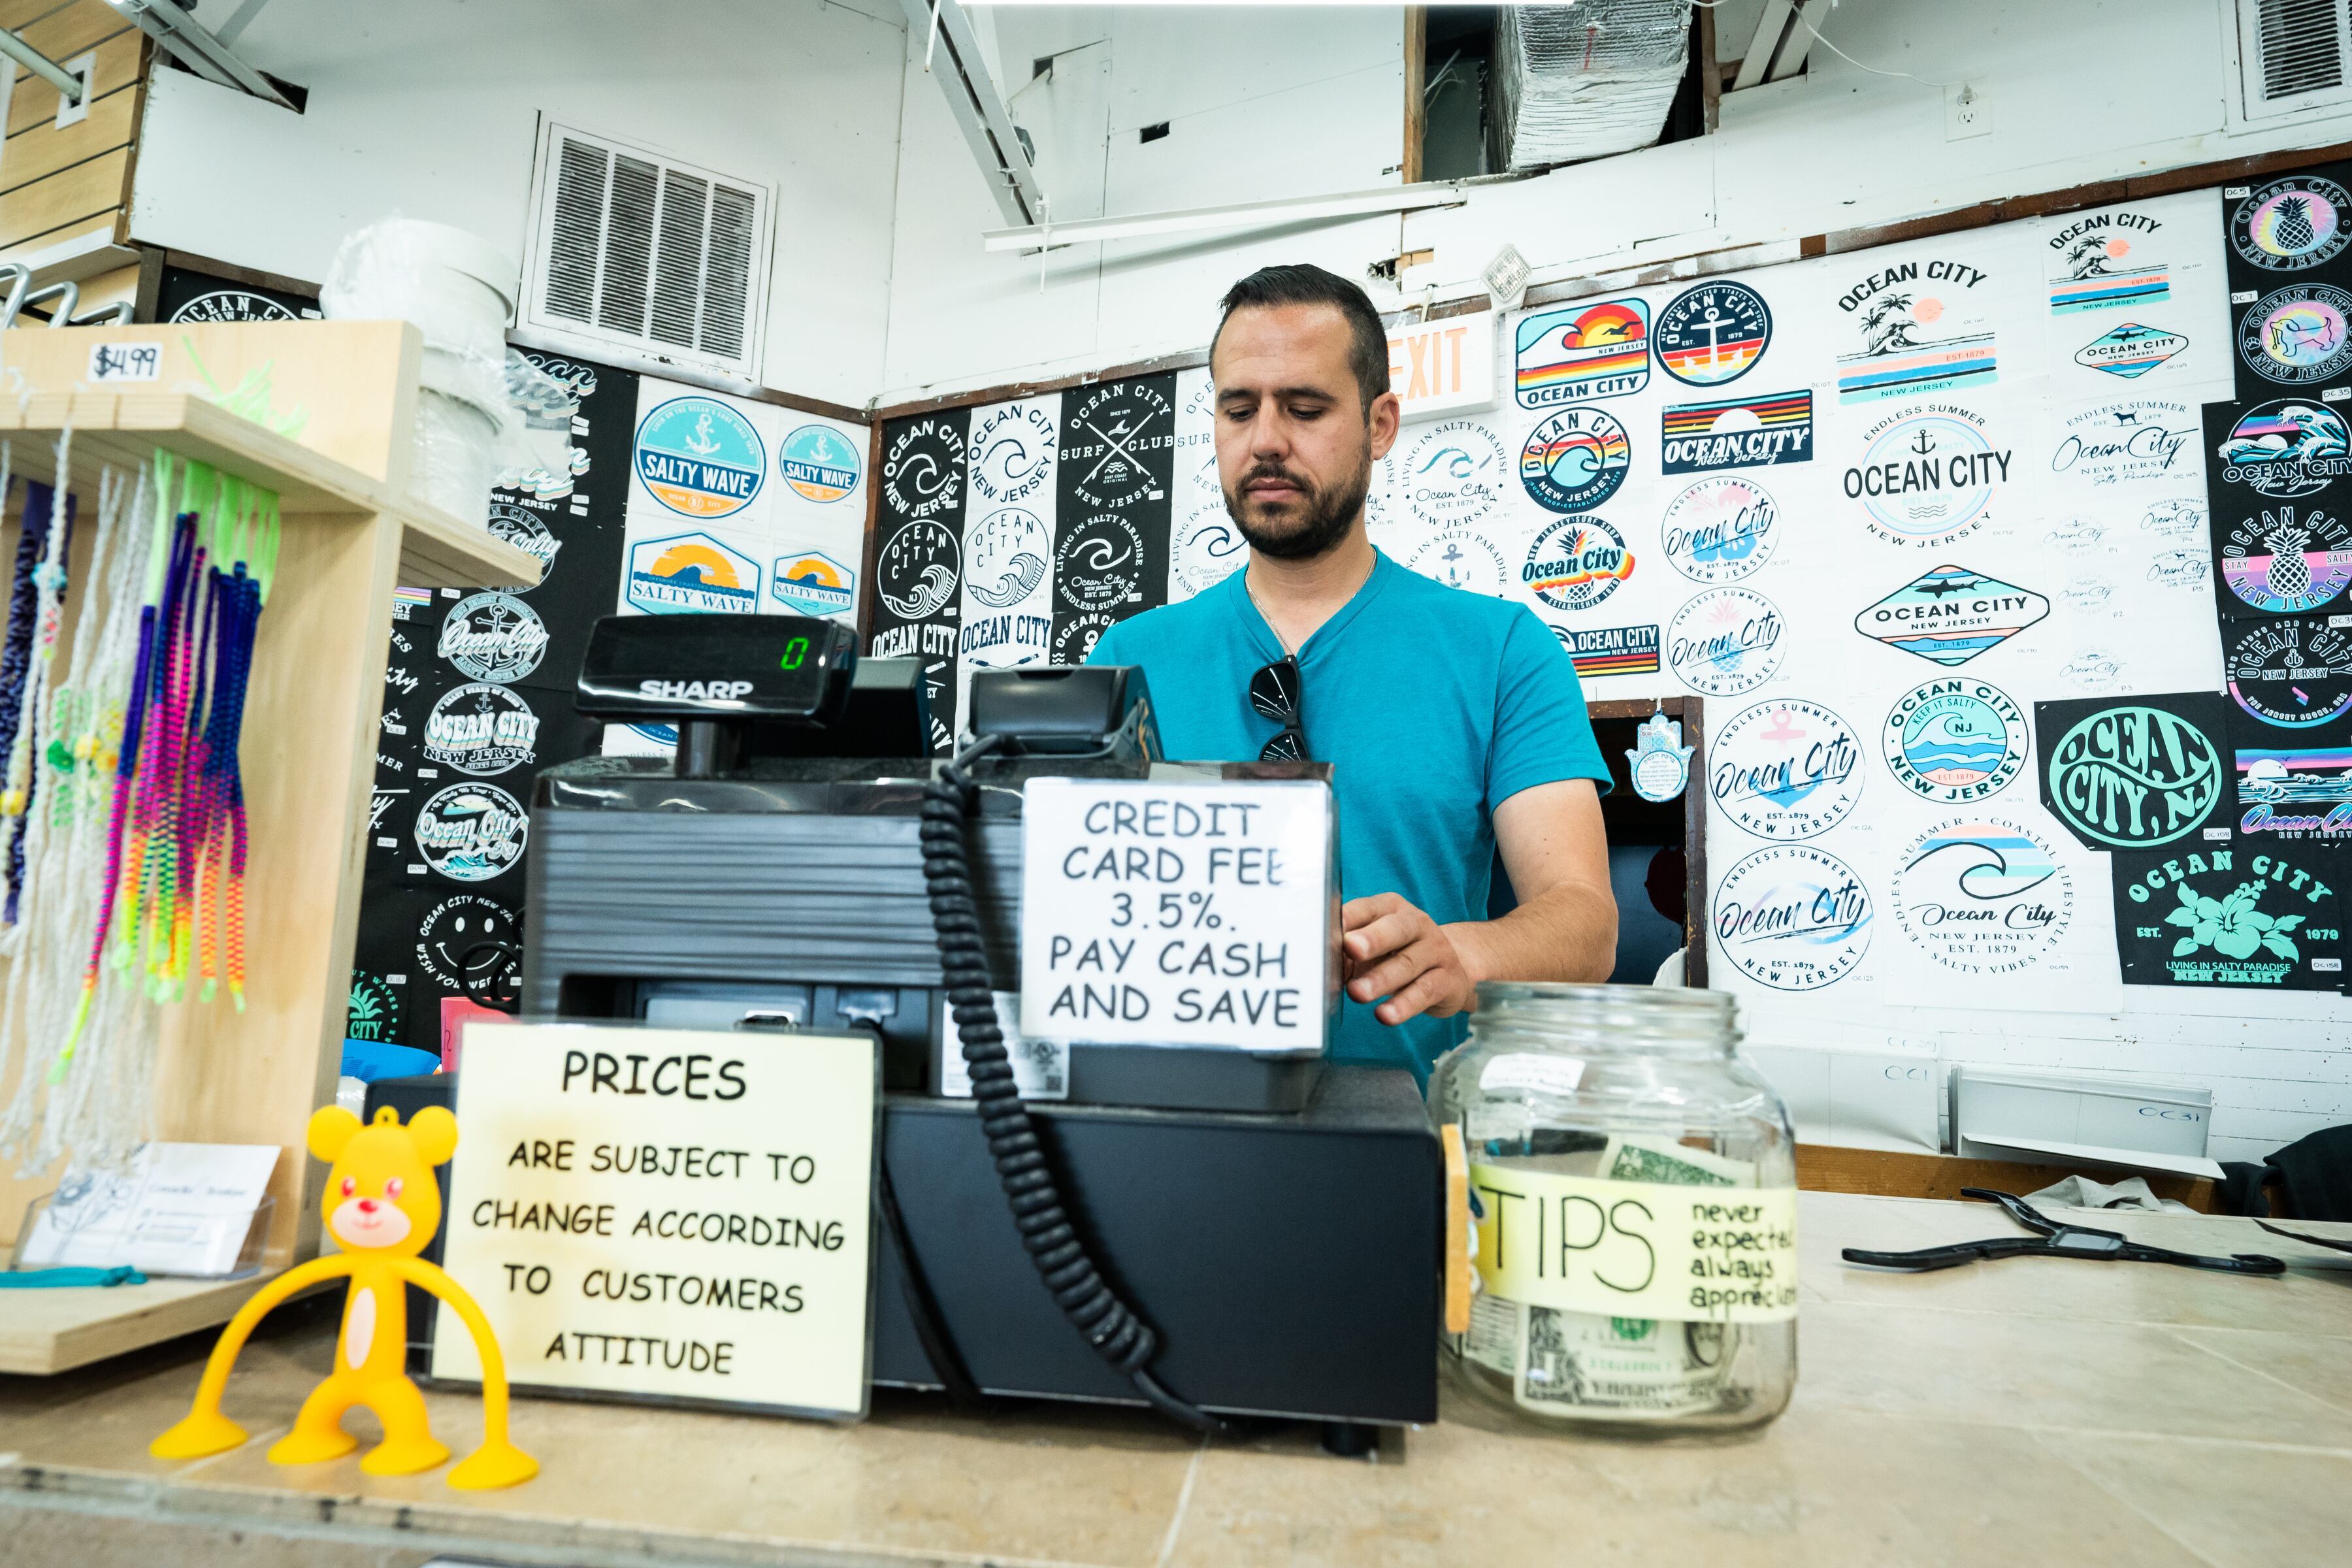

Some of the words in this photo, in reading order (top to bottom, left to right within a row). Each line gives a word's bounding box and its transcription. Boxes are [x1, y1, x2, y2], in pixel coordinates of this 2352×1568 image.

[2236, 181, 2296, 223] Ocean
[2307, 180, 2347, 208] City
[2050, 213, 2111, 250] OCEAN
[2116, 213, 2163, 235] CITY
[1838, 262, 1919, 313] OCEAN
[1927, 261, 1987, 289] CITY
[1667, 294, 1714, 344] OCEAN
[1725, 295, 1757, 331] CITY
[2249, 289, 2308, 327] OCEAN
[2315, 290, 2352, 316] CITY
[93, 345, 156, 378] $4.99
[1599, 346, 1616, 355] NEW
[1618, 341, 1644, 353] JERSEY
[2087, 342, 2137, 357] OCEAN
[2142, 337, 2176, 350] CITY
[1071, 384, 1124, 429] OCEAN
[1134, 385, 1171, 416] CITY
[1527, 382, 1588, 405] OCEAN
[1596, 376, 1639, 393] CITY
[1880, 389, 1906, 398] NEW
[1909, 380, 1953, 393] JERSEY
[883, 420, 935, 478] OCEAN
[938, 425, 966, 466] CITY
[1061, 444, 1104, 460] SURF
[1128, 435, 1173, 451] CLUB
[1403, 446, 1420, 487] LIVING
[1420, 433, 1432, 445] IN
[1435, 421, 1474, 435] SALTY
[1477, 426, 1507, 475] PARADISE
[1525, 413, 1578, 471] OCEAN
[1591, 416, 1625, 460] CITY
[1665, 433, 1743, 464] OCEAN
[1746, 427, 1810, 455] CITY
[1695, 452, 1730, 467] New
[1733, 449, 1778, 467] Jersey
[645, 455, 698, 485] SALTY
[702, 466, 751, 497] WAVE
[786, 462, 820, 483] SALTY
[821, 468, 852, 488] WAVE
[1844, 458, 1940, 498] OCEAN
[1949, 449, 2012, 487] CITY
[2223, 462, 2302, 482] OCEAN
[2308, 458, 2352, 476] CITY
[885, 483, 910, 514] NEW
[911, 471, 962, 518] JERSEY
[1416, 489, 1457, 502] Ocean
[1461, 483, 1492, 500] City
[1056, 535, 1074, 572] LIVING
[1074, 523, 1085, 534] IN
[1087, 514, 1119, 525] SALTY
[1119, 518, 1143, 566] PARADISE
[2223, 506, 2294, 557] OCEAN
[2306, 511, 2352, 550] CITY
[1522, 557, 1578, 581] Ocean
[1583, 547, 1620, 570] City
[2225, 561, 2248, 570] STAY
[632, 583, 693, 604] SALTY
[702, 593, 751, 613] WAVE
[1548, 596, 1601, 610] ESTABLISHED
[1603, 580, 1619, 596] 1879
[2231, 577, 2270, 606] NEW
[2281, 568, 2349, 610] JERSEY
[1875, 603, 1959, 622] OCEAN
[1972, 596, 2027, 613] CITY
[1944, 617, 1991, 628] JERSEY
[781, 637, 809, 670] 0
[872, 627, 922, 659] OCEAN
[923, 623, 957, 658] CITY
[1578, 631, 1625, 651] OCEAN
[1626, 628, 1657, 647] CITY
[1630, 645, 1658, 654] JERSEY
[2237, 629, 2298, 678] OCEAN
[2309, 634, 2352, 674] CITY
[639, 680, 754, 700] SHARP
[1890, 681, 1962, 727] OCEAN
[1976, 685, 2019, 724] CITY
[2247, 696, 2262, 710] THE
[2262, 708, 2295, 721] JERSEY
[2300, 707, 2333, 721] SHORE,
[2333, 693, 2347, 706] USA
[1720, 706, 1772, 747] ENDLESS
[1782, 704, 1838, 728] SUMMER
[1912, 705, 1932, 725] KEEP
[1933, 700, 1944, 711] IT
[1947, 698, 1977, 710] SALTY
[1954, 723, 1972, 732] NJ
[425, 711, 495, 751] OCEAN
[493, 711, 540, 751] CITY
[2059, 713, 2212, 781] OCEAN
[1715, 757, 1795, 799] Ocean
[1804, 732, 1857, 784] City
[1084, 800, 1261, 838] CREDIT
[2066, 764, 2160, 838] CITY,
[2164, 773, 2212, 830] NJ
[416, 813, 477, 849] Ocean
[1900, 817, 1964, 862] SUMMER
[1062, 847, 1184, 884] CARD
[1208, 847, 1286, 885] FEE
[1990, 817, 2057, 860] COASTAL
[2047, 864, 2074, 947] LIFESTYLE
[2129, 851, 2233, 902] OCEAN
[2252, 855, 2332, 902] CITY
[419, 904, 445, 937] OCEAN
[448, 896, 473, 908] CITY
[477, 898, 499, 909] NEW
[1891, 868, 1919, 944] ENDLESS
[1909, 904, 1998, 928] Ocean
[2004, 903, 2059, 929] City
[1930, 932, 1968, 941] NEW
[1972, 932, 2037, 941] JERSEY
[1948, 944, 1981, 954] EST.
[1987, 945, 2017, 954] 1879
[1050, 936, 1135, 974] PAY
[1158, 941, 1287, 978] CASH
[1931, 952, 1981, 973] SALTY
[1989, 955, 2037, 973] VIBES
[2166, 961, 2198, 970] LIVING
[2200, 962, 2210, 970] IN
[2212, 962, 2242, 972] SALTY
[2244, 962, 2291, 972] PARADISE
[2174, 970, 2213, 982] NEW
[2217, 971, 2285, 984] JERSEY
[1049, 983, 1150, 1021] AND
[1174, 988, 1301, 1028] SAVE
[563, 1051, 747, 1100] PRICES
[509, 1139, 575, 1171] ARE
[590, 1145, 749, 1179] SUBJECT
[766, 1152, 815, 1184] TO
[472, 1199, 615, 1237] CHANGE
[632, 1210, 845, 1250] ACCORDING
[1693, 1203, 1764, 1223] never
[1479, 1185, 1656, 1293] TIPS
[503, 1264, 552, 1295] TO
[583, 1269, 804, 1313] CUSTOMERS
[1691, 1258, 1774, 1287] always
[545, 1331, 734, 1375] ATTITUDE
